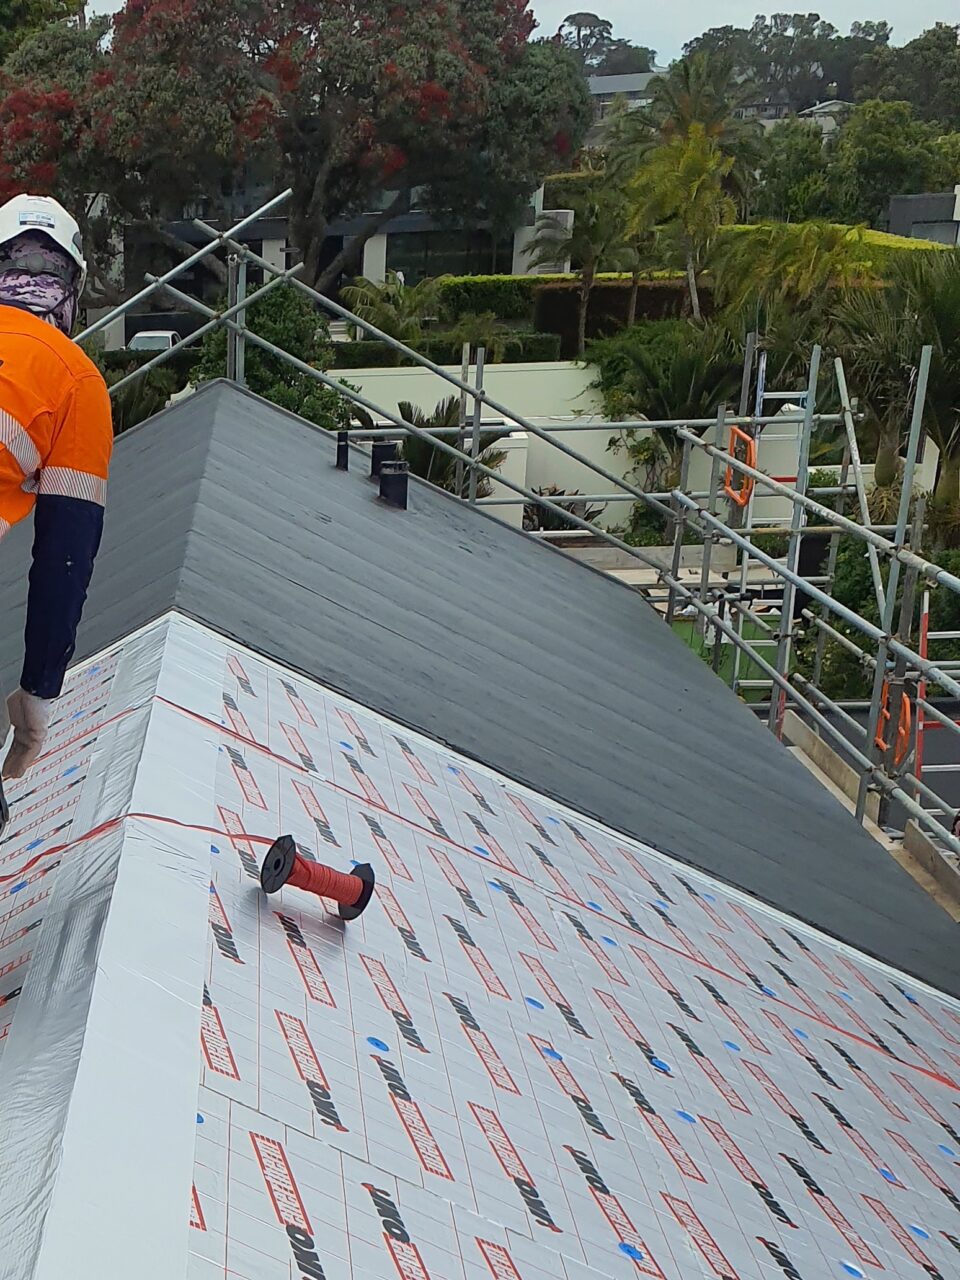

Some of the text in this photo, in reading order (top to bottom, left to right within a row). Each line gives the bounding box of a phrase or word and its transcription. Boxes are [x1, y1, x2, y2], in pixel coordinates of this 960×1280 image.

[224, 746, 248, 770] IKO
[312, 817, 338, 844] IKO
[277, 914, 336, 1008] IKO enertherm
[397, 927, 427, 958] IKO
[359, 952, 410, 1018] enertherm
[390, 1011, 425, 1049] IKO
[447, 995, 480, 1030] IKO
[275, 1009, 342, 1127] IKO enertherm
[570, 1095, 608, 1135] IKO
[619, 1077, 656, 1114] IKO
[376, 1059, 453, 1181] IKO enertherm
[469, 1101, 533, 1185] enertherm
[251, 1131, 311, 1233] enertherm
[569, 1150, 610, 1194] IKO
[368, 1188, 410, 1241] IKO
[512, 1178, 555, 1226] IKO
